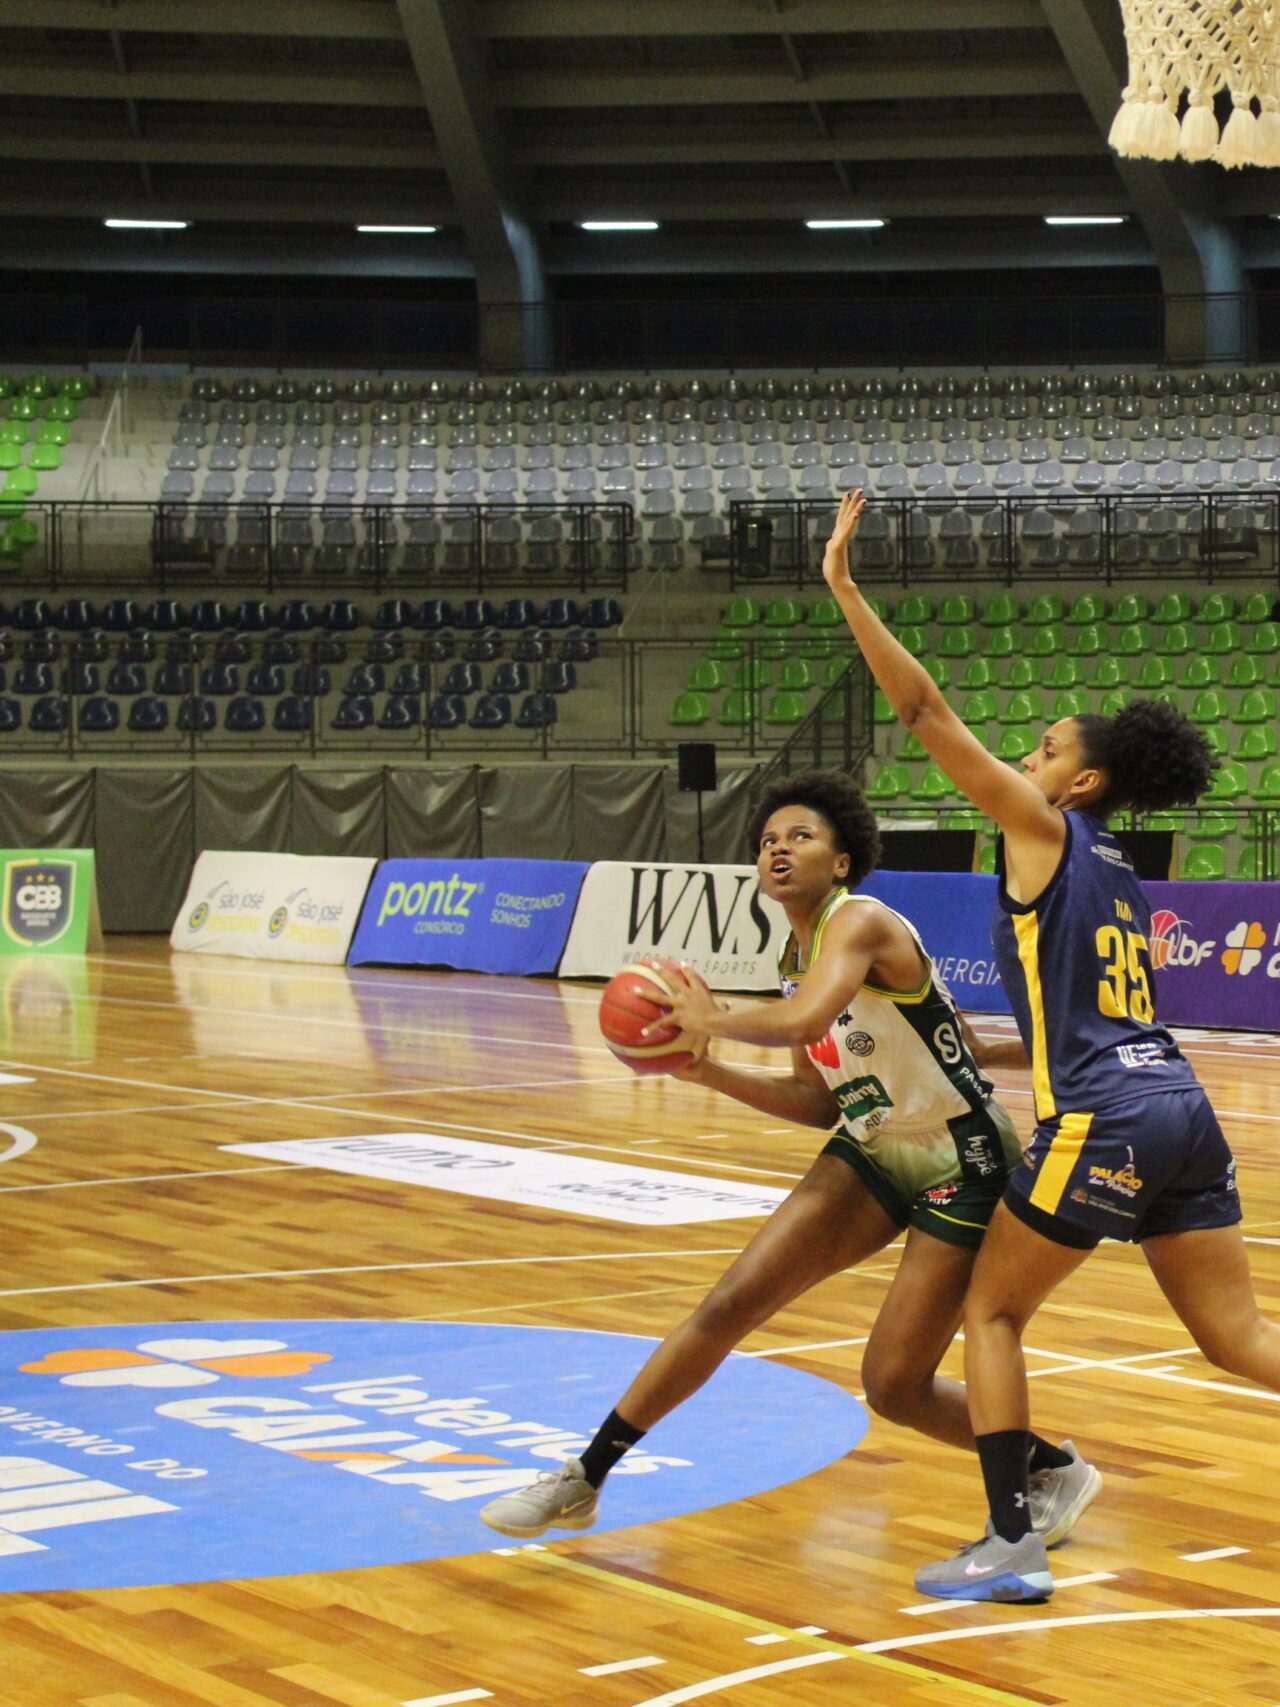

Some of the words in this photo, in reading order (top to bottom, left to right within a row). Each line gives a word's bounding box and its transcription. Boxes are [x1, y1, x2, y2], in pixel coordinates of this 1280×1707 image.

[15, 884, 62, 911] CBB
[376, 873, 477, 927] pontz
[495, 892, 566, 912] CONECTANDO
[490, 908, 532, 928] SONHOS
[627, 867, 771, 954] WNS
[703, 960, 758, 975] SPORTS
[1095, 925, 1154, 1025] 35
[124, 1458, 209, 1479] DO
